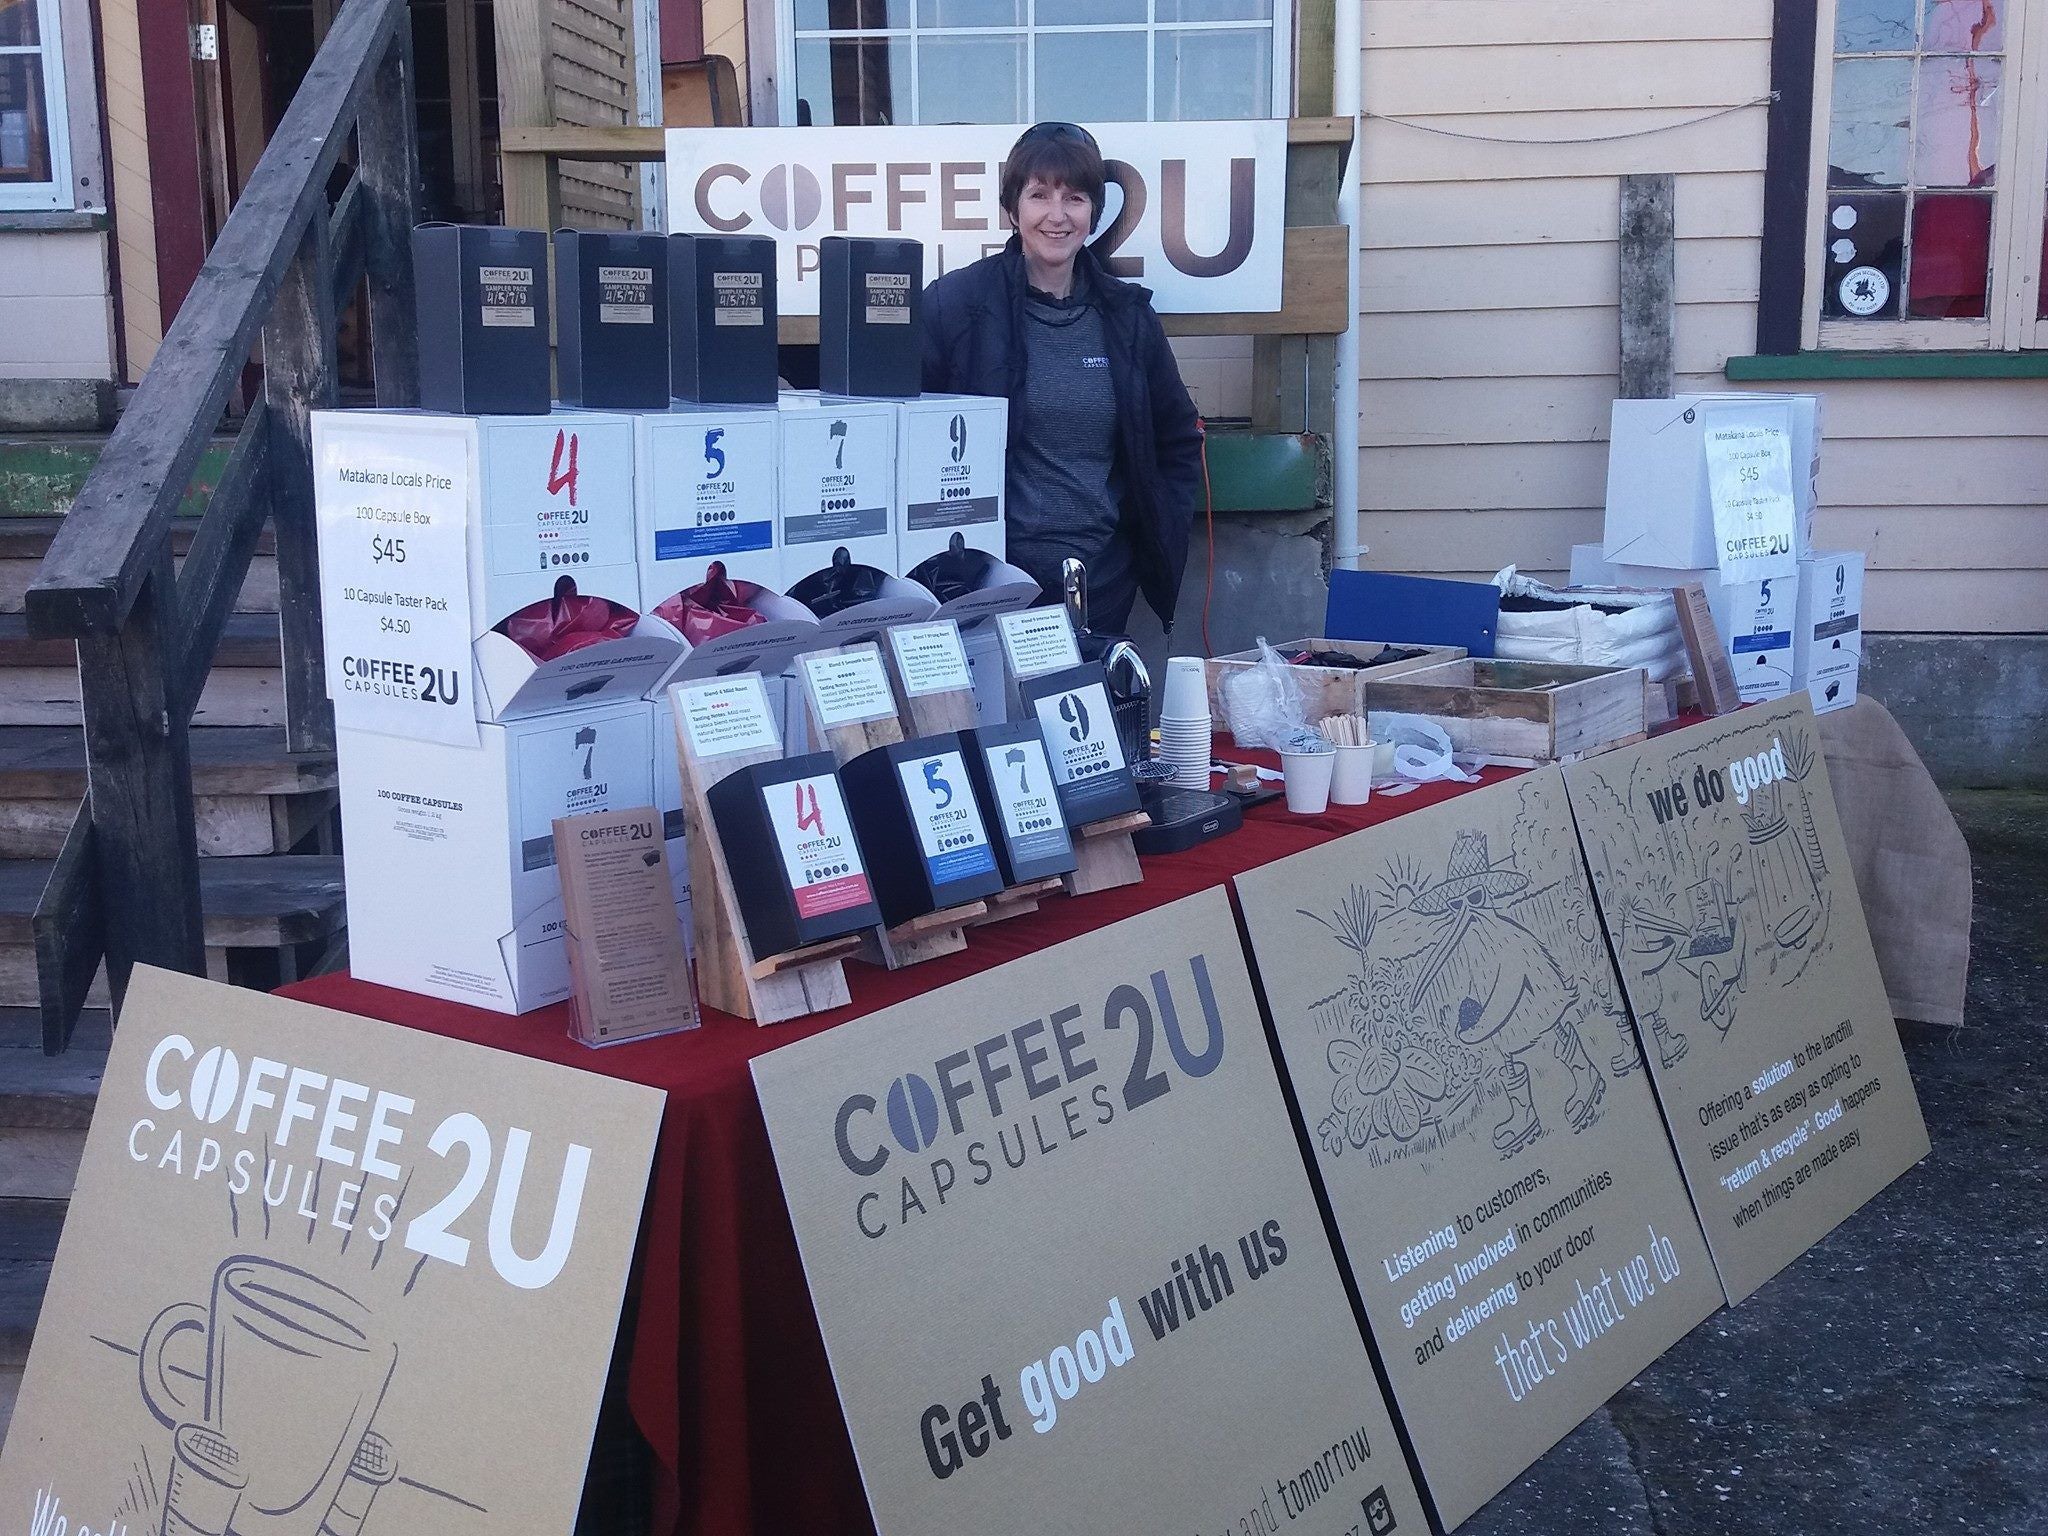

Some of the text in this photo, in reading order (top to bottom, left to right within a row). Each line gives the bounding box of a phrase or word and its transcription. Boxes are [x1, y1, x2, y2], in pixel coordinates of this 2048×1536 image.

[1088, 158, 1256, 278] 2U
[512, 270, 526, 281] 2U
[632, 270, 646, 281] 2U
[704, 427, 725, 479] 5
[829, 420, 848, 470] 7
[949, 413, 967, 463] 9
[1715, 430, 1745, 440] Matakana
[339, 468, 452, 490] Matakana Locals Price
[547, 428, 579, 507] 4
[821, 475, 855, 485] COFFEE 2U
[960, 465, 971, 475] 2U
[1740, 466, 1760, 483] $45
[722, 482, 735, 493] 2U
[356, 506, 431, 525] 100 Capsule Box
[537, 510, 589, 524] COFFEE 2U
[372, 533, 406, 564] $45
[1726, 533, 1789, 556] COFFEE 2U
[1728, 550, 1769, 561] CAPSULES
[344, 587, 448, 611] 10 Capsule Taster Pack
[1760, 579, 1773, 607] 5
[1835, 564, 1845, 596] 9
[380, 616, 411, 634] $4.50
[343, 655, 459, 706] COFFEE 2U
[344, 678, 418, 701] CAPSULES
[1059, 693, 1090, 743] 9
[574, 726, 597, 780] 7
[1063, 741, 1105, 757] COFFEE 2U
[922, 759, 952, 810] 5
[1005, 747, 1031, 794] 7
[1647, 737, 1787, 825] we do good
[378, 789, 463, 812] 100 COFFEE CAPSULES
[567, 784, 608, 797] COFFEE 2U
[796, 782, 825, 836] 4
[1012, 797, 1047, 809] COFFEE 2U
[581, 823, 653, 840] COFFEE 2U
[929, 808, 968, 823] COFFEE 2U
[797, 836, 841, 851] COFFEE 2U
[542, 921, 558, 933] 100
[834, 954, 1224, 1176] COFFEE 2U
[1699, 1019, 1854, 1127] Offering a solution to the landfill
[1709, 1053, 1862, 1162] issue that's as easy as opting to
[1761, 1149, 1772, 1169] &
[1814, 1099, 1843, 1131] Good
[1841, 1076, 1882, 1112] happens
[128, 1119, 399, 1242] CAPSULES
[146, 1034, 593, 1289] COFFEE 2U
[856, 1085, 1114, 1239] CAPSULES
[1733, 1127, 1862, 1229] when things are made easy
[1383, 1168, 1551, 1283] Listening to customers,
[1400, 1169, 1613, 1329] getting Involved in communities
[1415, 1224, 1597, 1366] and delivering to your door
[1495, 1224, 1681, 1402] that's what we do
[920, 1218, 1288, 1479] Get good with us
[1239, 1426, 1371, 1536] and tomorrow
